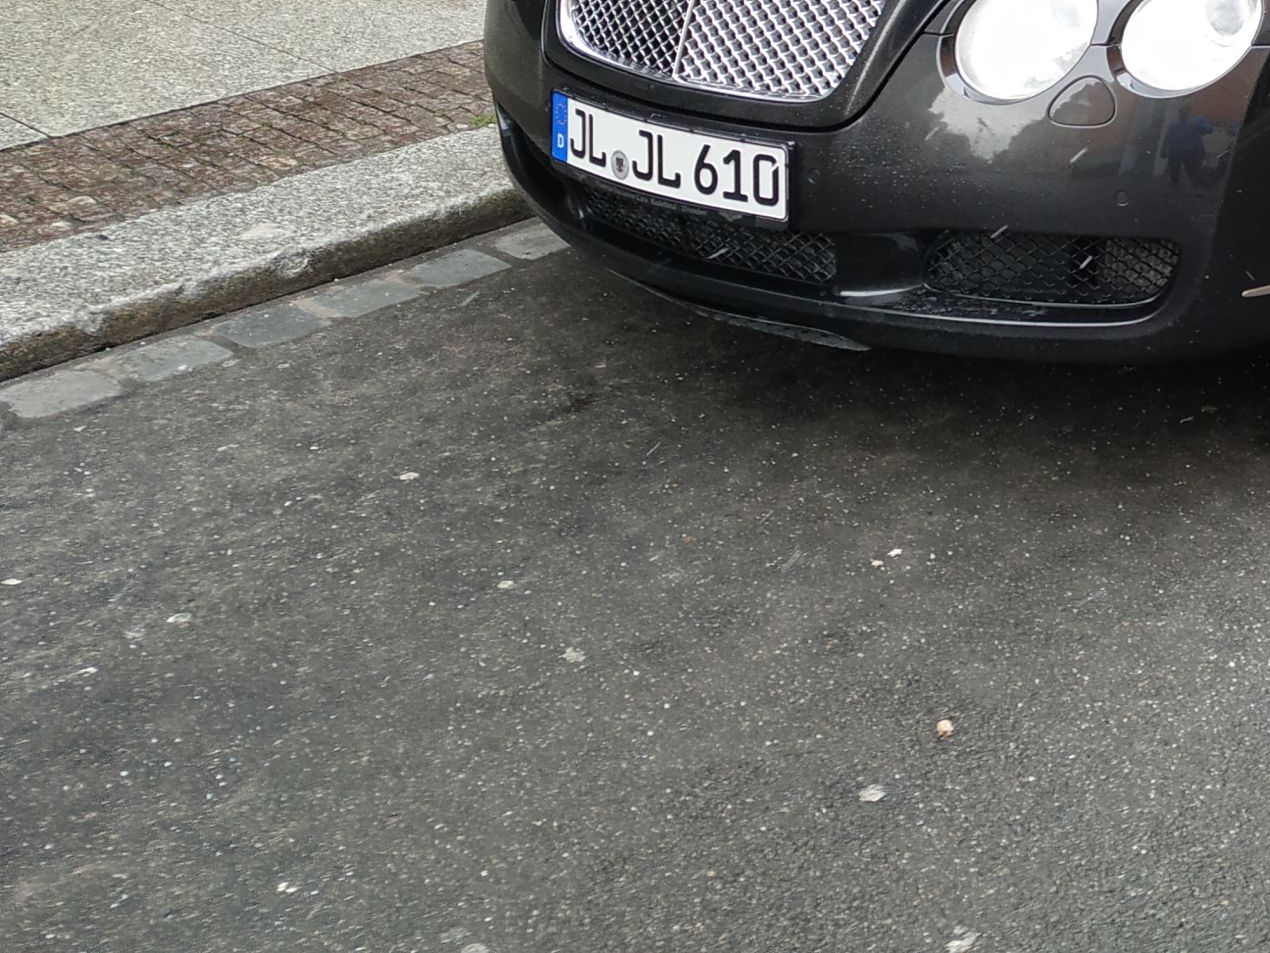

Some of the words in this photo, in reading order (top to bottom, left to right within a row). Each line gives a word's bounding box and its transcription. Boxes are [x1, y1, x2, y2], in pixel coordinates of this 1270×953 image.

[556, 133, 565, 149] D
[569, 107, 607, 168] JL
[632, 129, 682, 189] JL
[694, 144, 780, 207] 610
